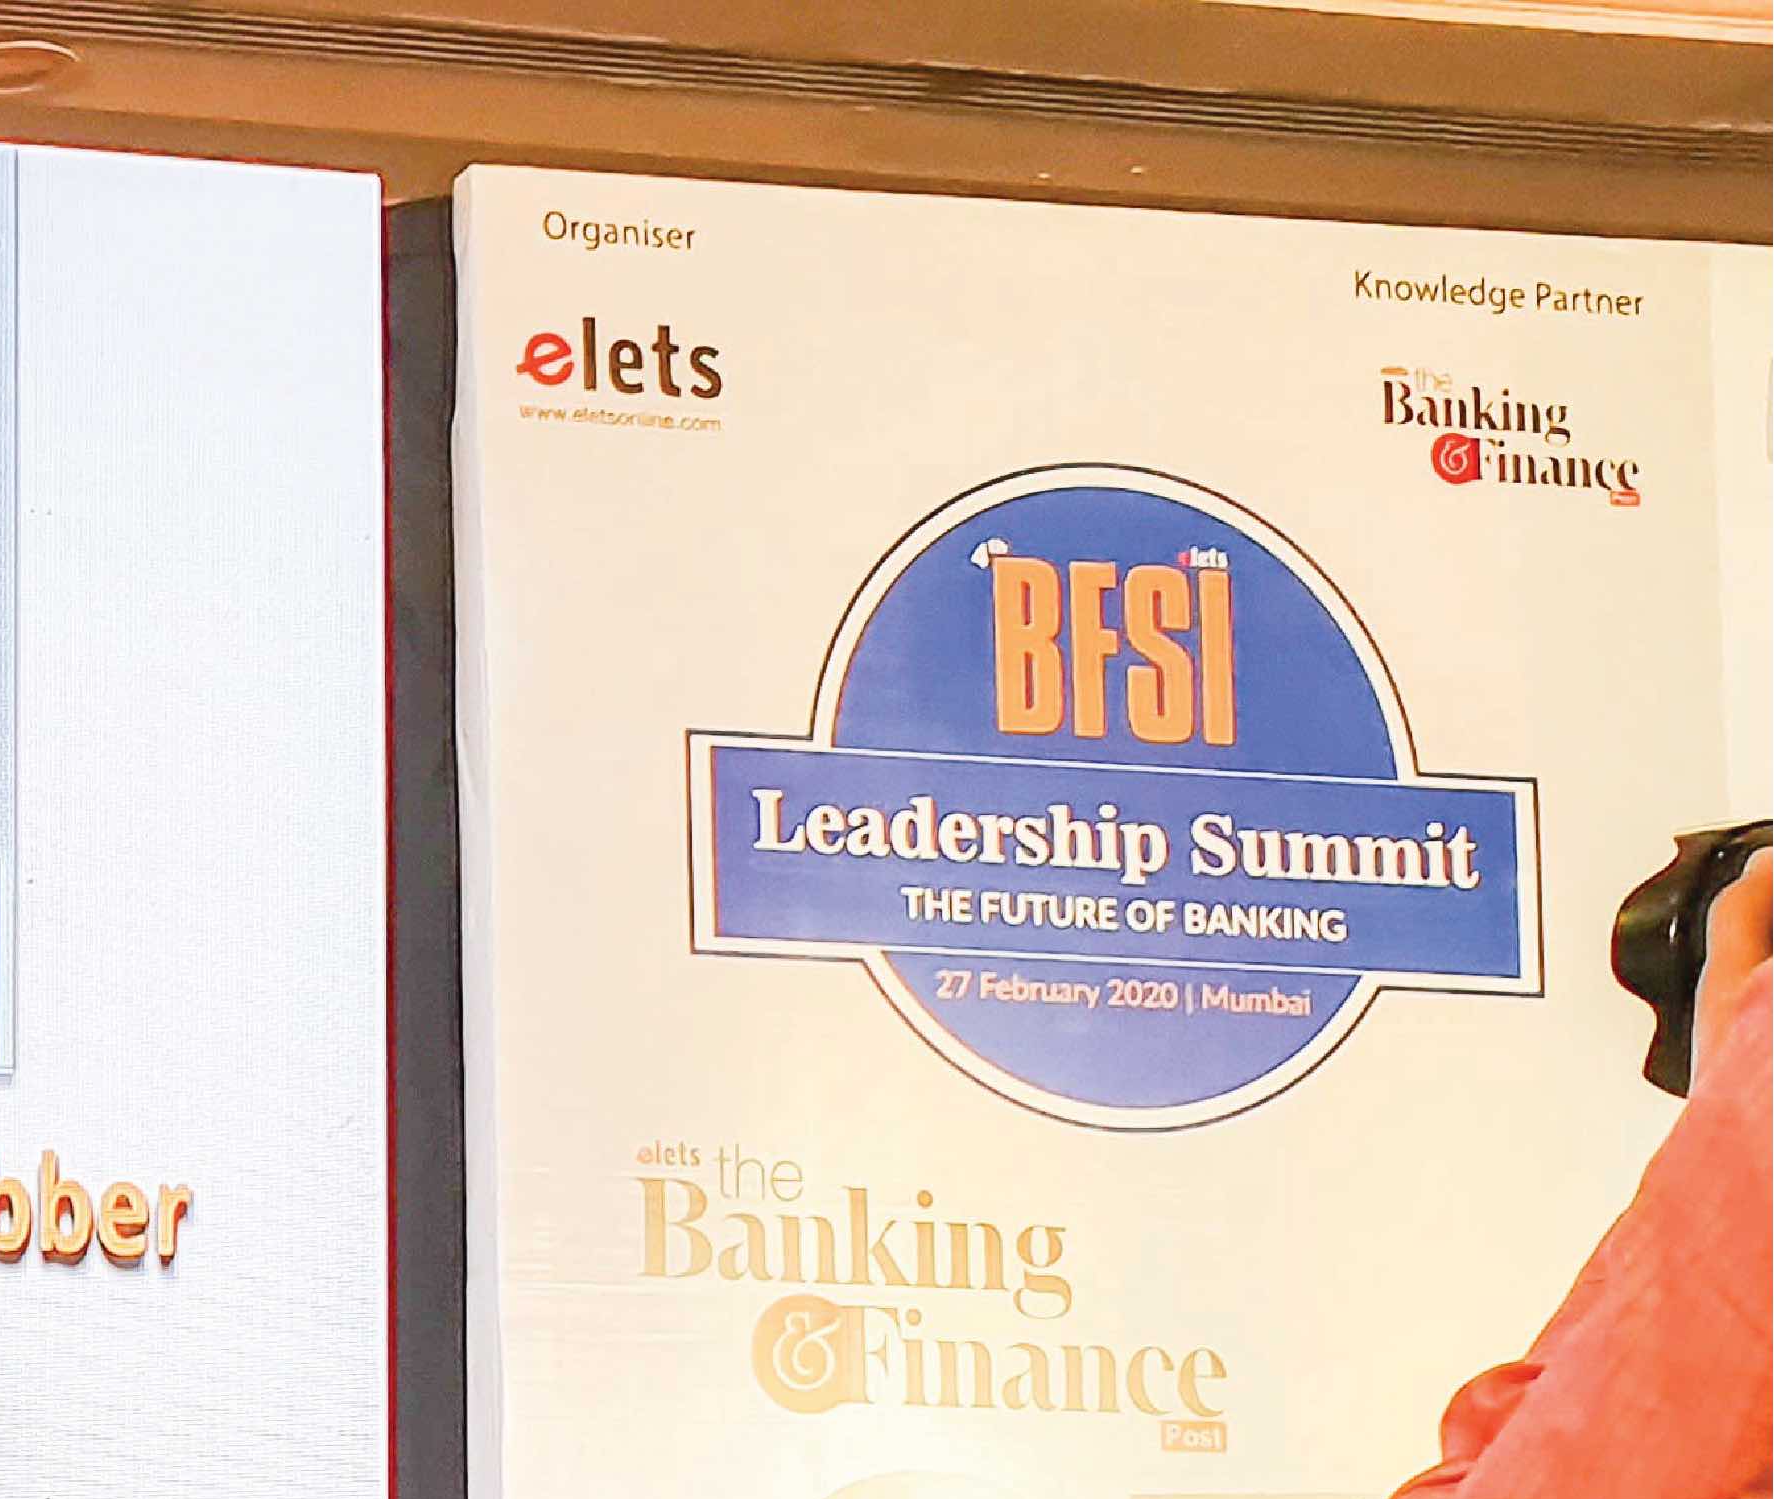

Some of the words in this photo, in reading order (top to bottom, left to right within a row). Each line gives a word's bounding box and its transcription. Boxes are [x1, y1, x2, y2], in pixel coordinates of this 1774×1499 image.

[543, 211, 695, 251] Organiser
[1354, 270, 1525, 315] Knowledge
[1536, 282, 1644, 316] Partner
[516, 317, 722, 398] elets
[1383, 380, 1571, 447] Banking
[992, 556, 1236, 746] BFSI
[752, 788, 1169, 886] Leadership
[1191, 813, 1481, 890] Summit
[901, 886, 973, 924] THE
[980, 892, 1118, 932] FUTURE
[1126, 902, 1175, 934] OF
[1183, 902, 1348, 943] BANKING
[934, 970, 972, 1001] 27
[979, 971, 1100, 1010] February
[1108, 979, 1178, 1009] 2020
[1201, 986, 1311, 1017] Mumbai
[636, 1139, 701, 1168] elets
[715, 1142, 804, 1203] the
[635, 1177, 1072, 1320] Banking
[1166, 1424, 1223, 1452] Post
